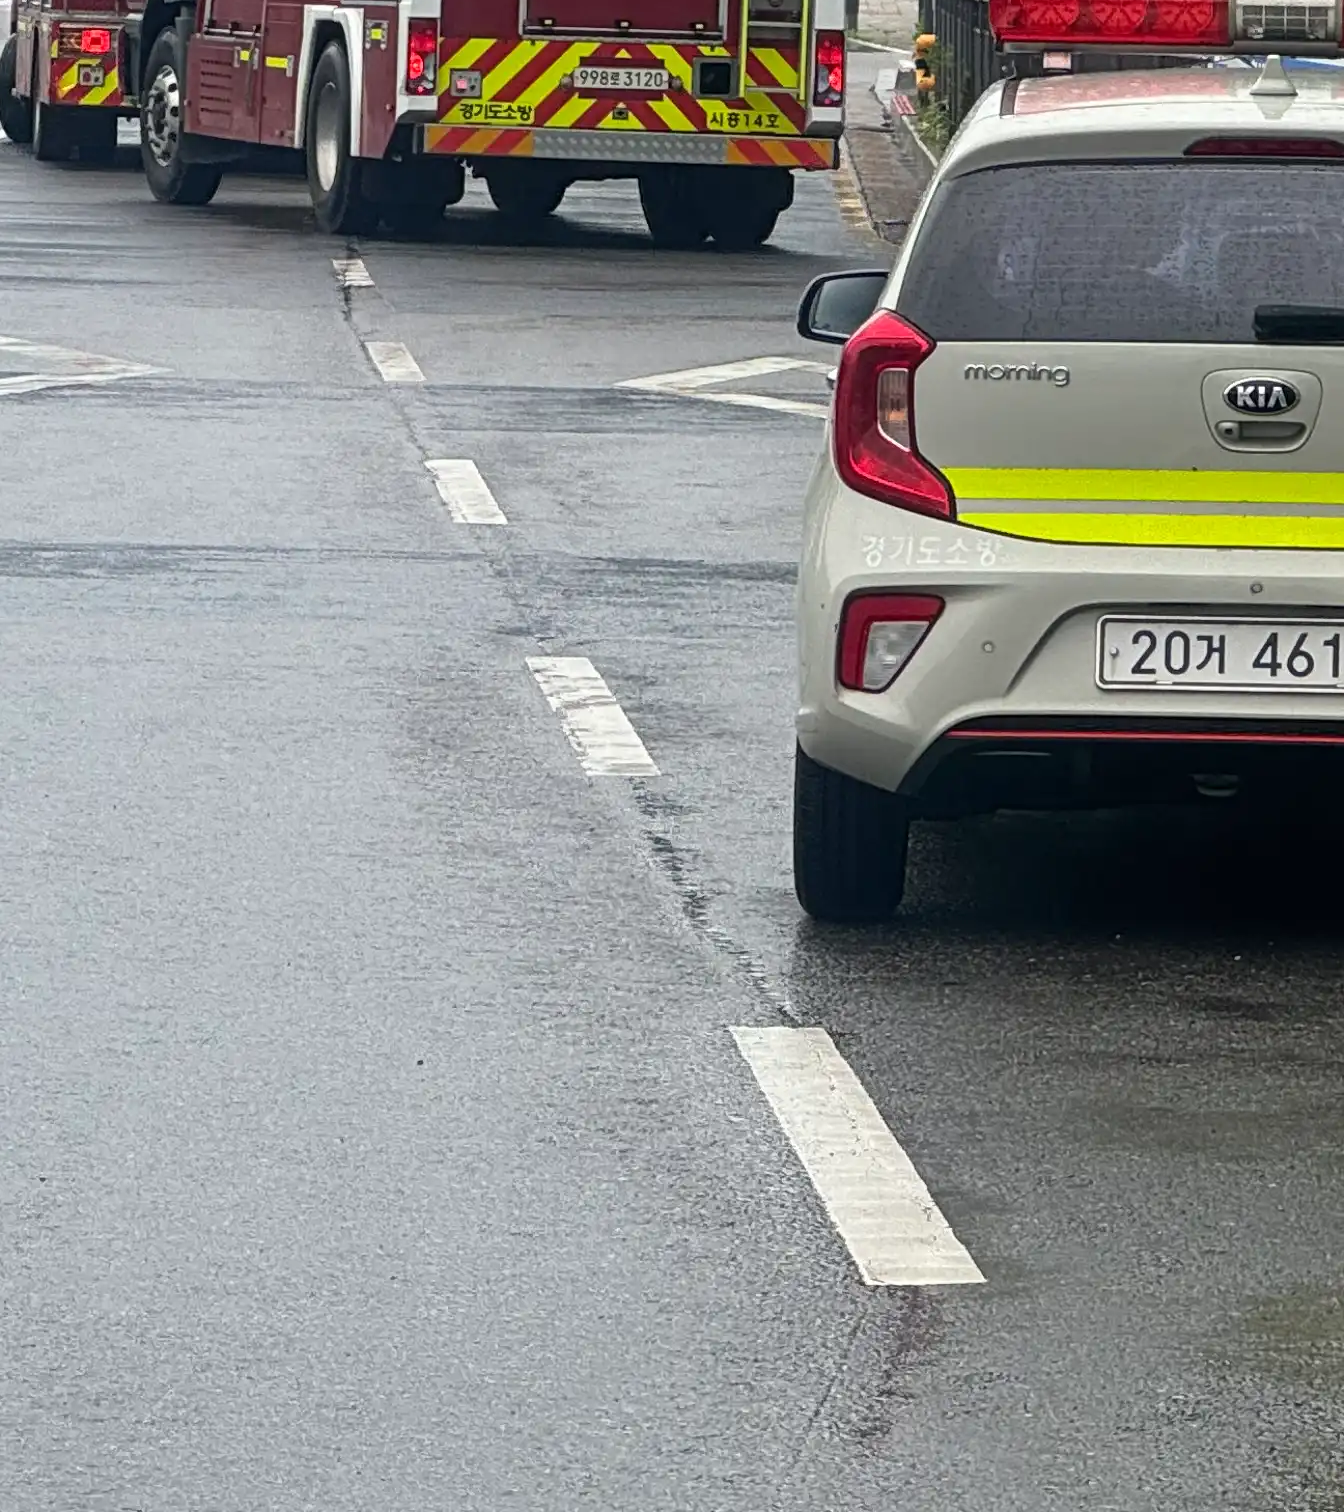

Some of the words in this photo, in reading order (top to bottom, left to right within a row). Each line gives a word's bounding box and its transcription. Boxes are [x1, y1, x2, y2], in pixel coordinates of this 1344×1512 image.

[623, 71, 664, 88] 3120
[459, 103, 533, 121] 경기도소방
[964, 362, 1070, 387] morning
[1236, 386, 1289, 409] KIA
[859, 535, 1003, 567] 경기도소방
[1131, 630, 1226, 675] 20거
